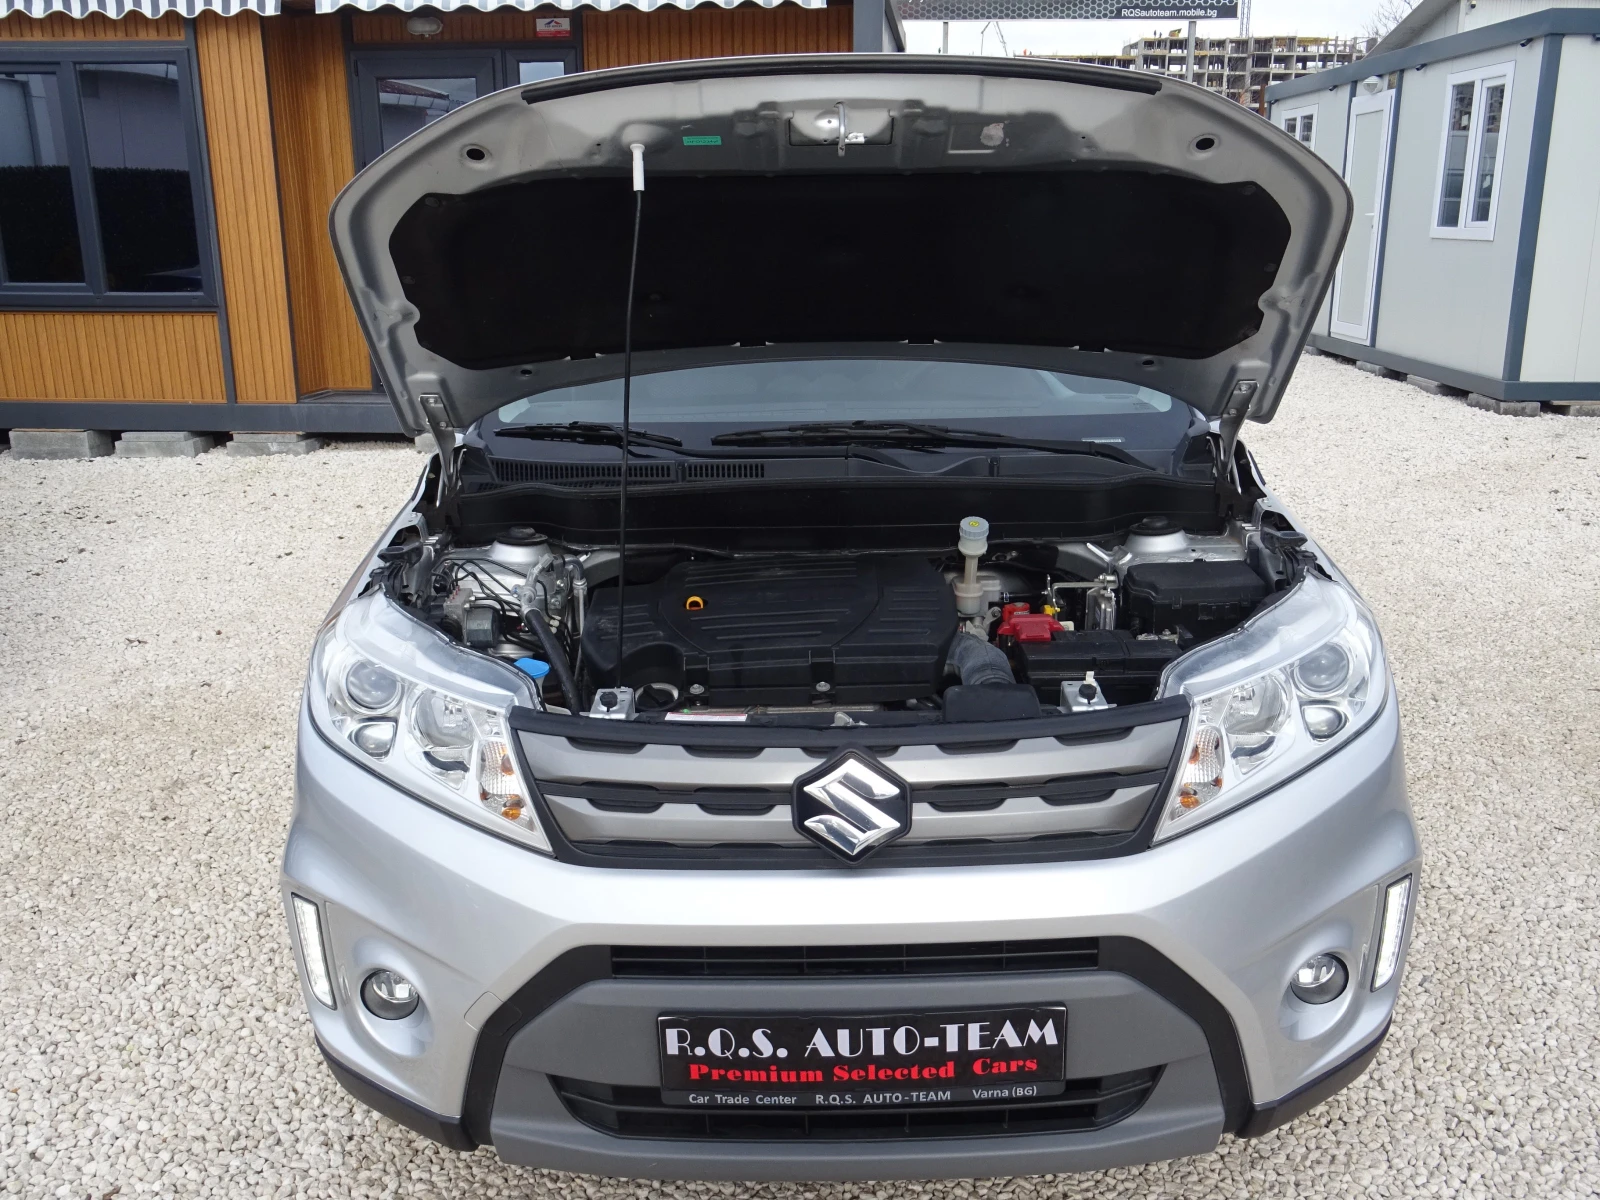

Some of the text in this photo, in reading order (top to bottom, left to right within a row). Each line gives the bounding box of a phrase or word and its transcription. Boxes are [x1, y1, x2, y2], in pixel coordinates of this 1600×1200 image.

[1121, 8, 1218, 18] RQSautoteam.mobile.bg
[665, 1018, 1058, 1059] R.Q.S. AUTO-TEAM
[689, 1057, 1037, 1082] Premium Selected Cars
[688, 1093, 709, 1104] Car
[715, 1093, 750, 1104] Trade
[755, 1094, 796, 1104] Center
[815, 1094, 856, 1105] R.Q.S.
[972, 1088, 1009, 1099] Varna
[1012, 1085, 1037, 1097] (BG)
